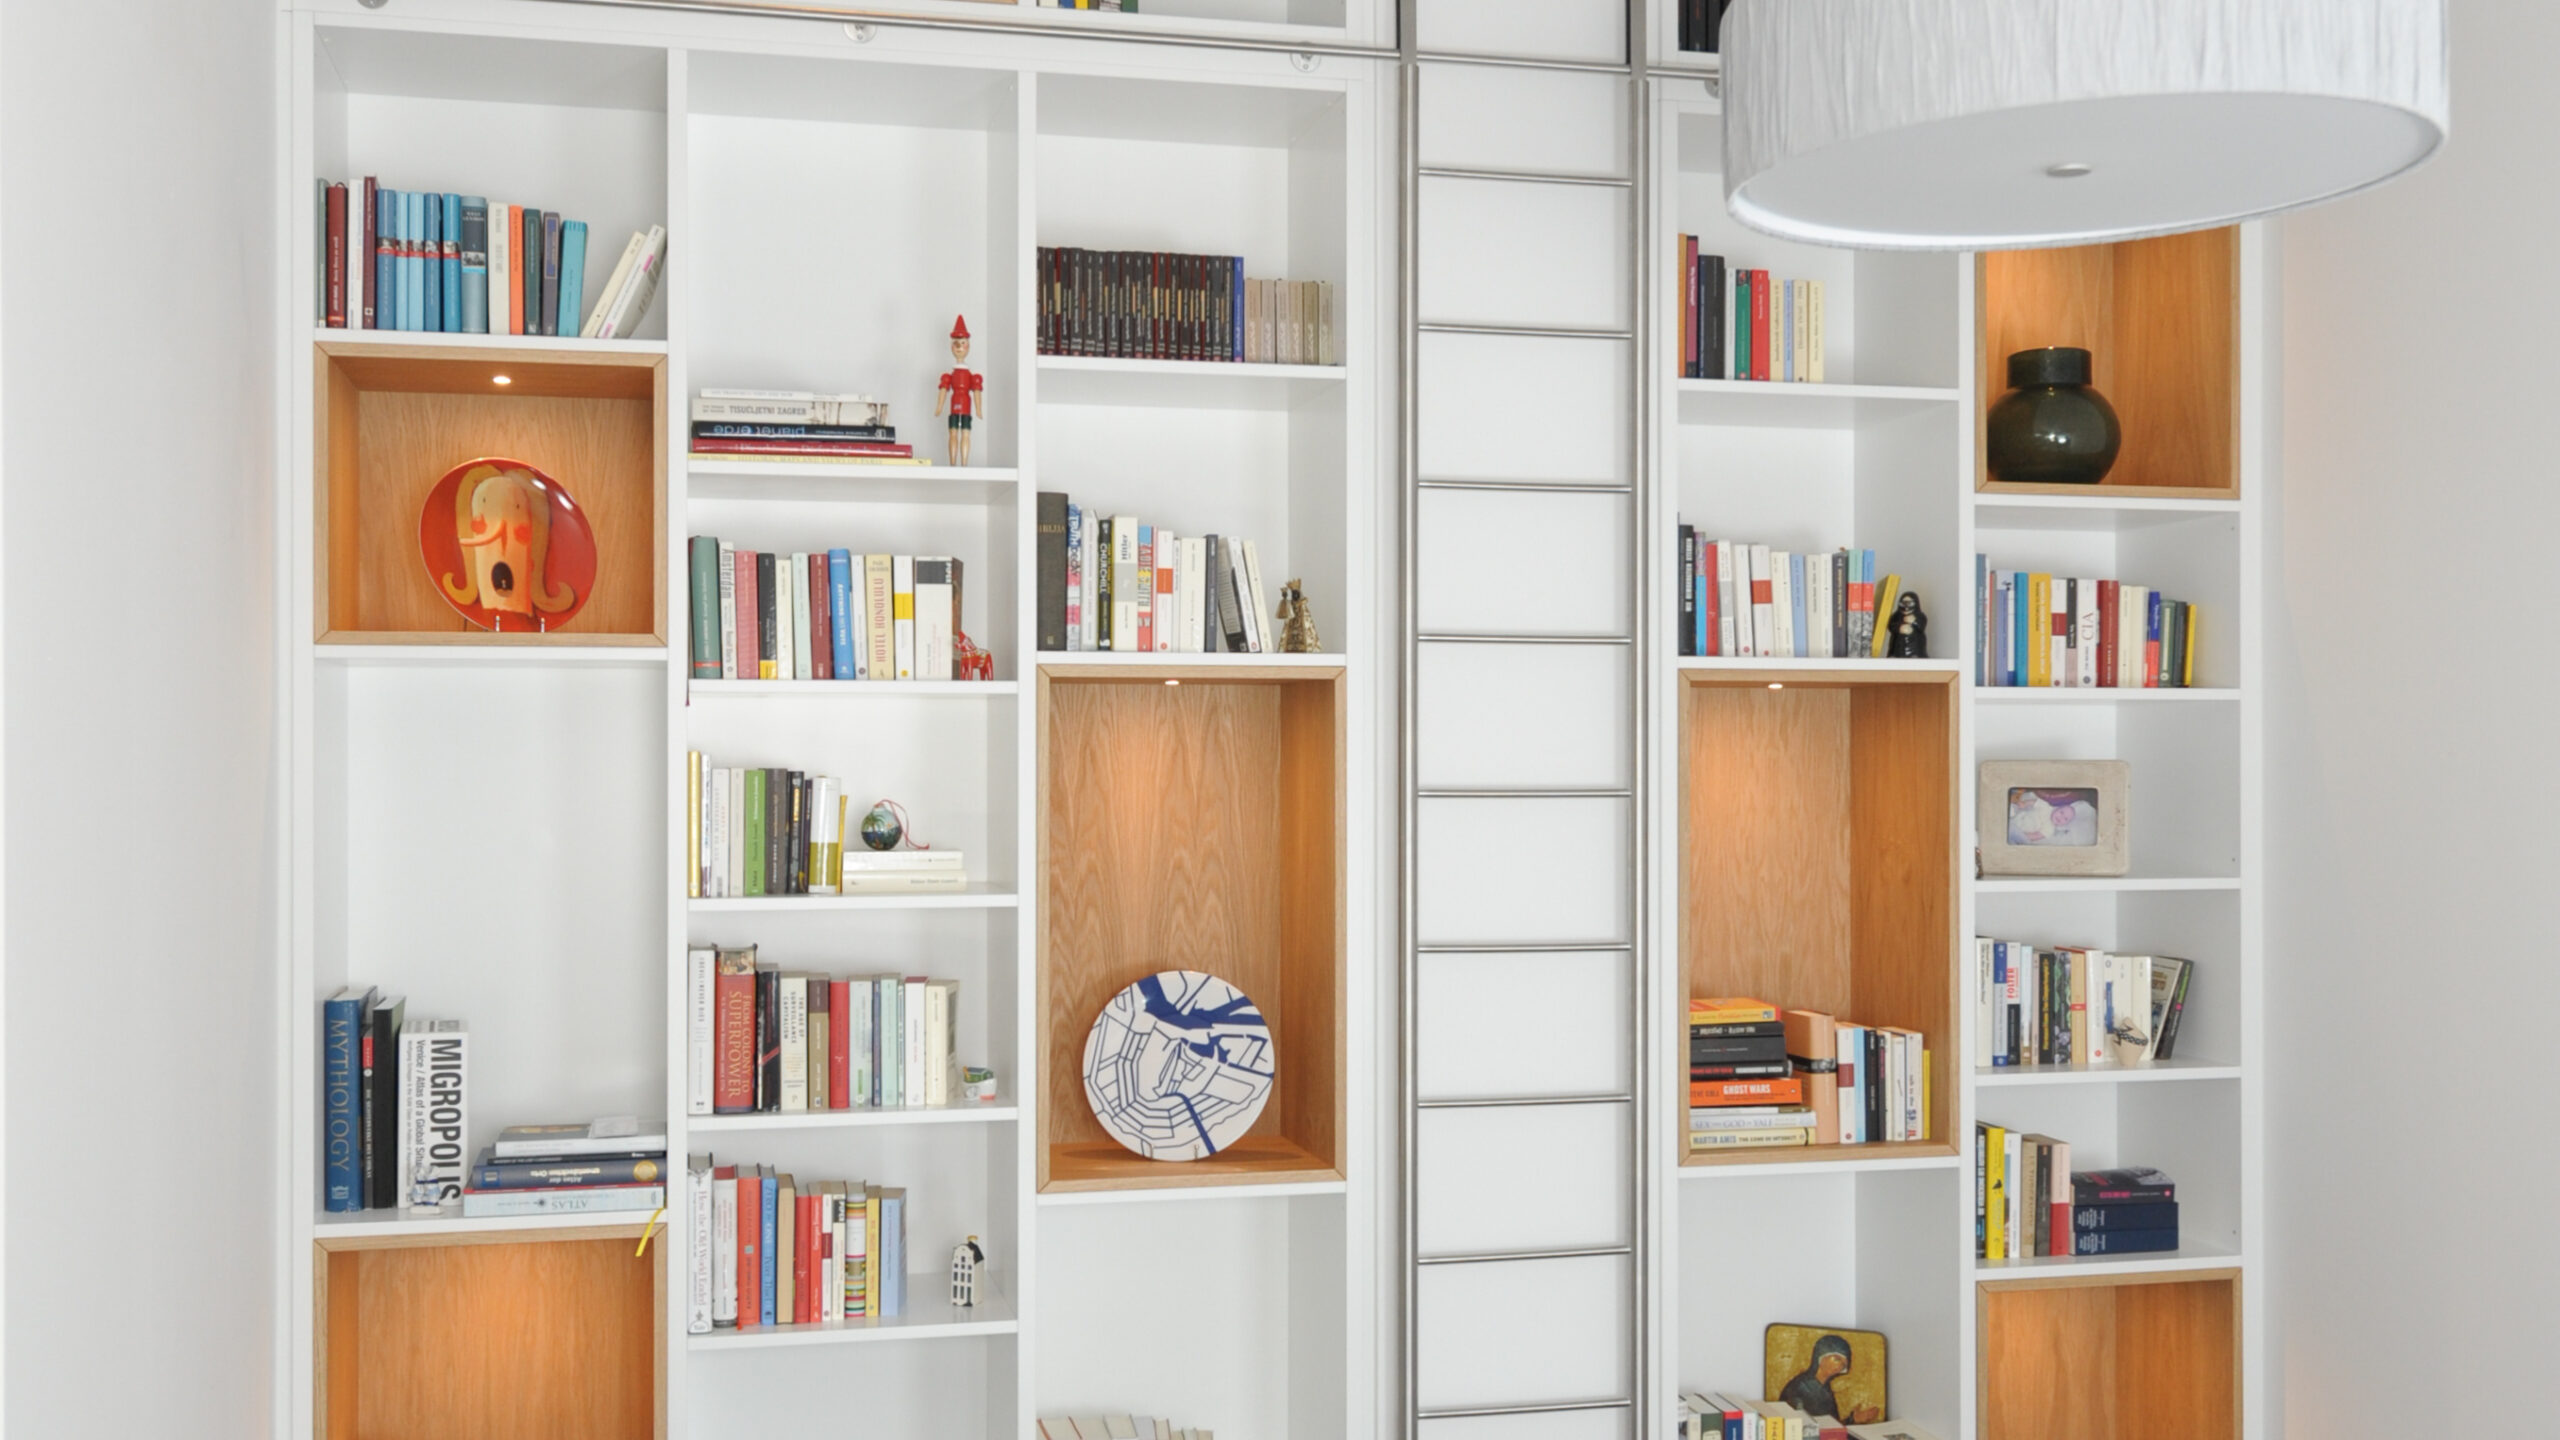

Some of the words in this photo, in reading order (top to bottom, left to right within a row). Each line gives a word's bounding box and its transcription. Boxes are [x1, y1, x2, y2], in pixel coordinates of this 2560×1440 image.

[777, 405, 807, 415] ZAGREB
[713, 424, 753, 435] erde
[755, 423, 806, 436] planet
[1069, 515, 1079, 545] TRUTH
[1121, 534, 1129, 560] Hitler
[720, 548, 734, 599] Amsterdam
[1069, 547, 1080, 577] DECAY
[1099, 543, 1107, 593] CHURCHILL
[873, 578, 885, 629] HONOLULU
[2081, 612, 2094, 641] CIA
[875, 634, 887, 663] HOTEL
[743, 994, 752, 1024] FROM
[728, 991, 742, 1099] SUPERPOWER
[799, 1029, 805, 1038] OF
[415, 1040, 426, 1066] Venice
[743, 1028, 752, 1074] COLONY
[329, 1019, 350, 1172] MYTHOLOGY
[415, 1077, 426, 1098] Atlas
[743, 1080, 752, 1093] TO
[1723, 1084, 1749, 1095] GHOST
[1750, 1084, 1771, 1094] WARS
[415, 1100, 426, 1109] of
[415, 1118, 426, 1145] Global
[430, 1039, 463, 1201] MIGROPOLIS
[1694, 1120, 1710, 1128] SEX
[1723, 1119, 1745, 1128] GOD
[1753, 1118, 1772, 1127] YALE
[1693, 1136, 1718, 1144] MARTIN
[1719, 1135, 1736, 1144] AMIS
[564, 1176, 583, 1184] Atlas
[551, 1199, 588, 1210] ATLAS
[698, 1190, 707, 1211] How
[698, 1214, 707, 1227] the
[764, 1222, 773, 1243] ONE
[698, 1230, 707, 1247] Old
[698, 1249, 707, 1275] World
[698, 1278, 707, 1306] Ended
